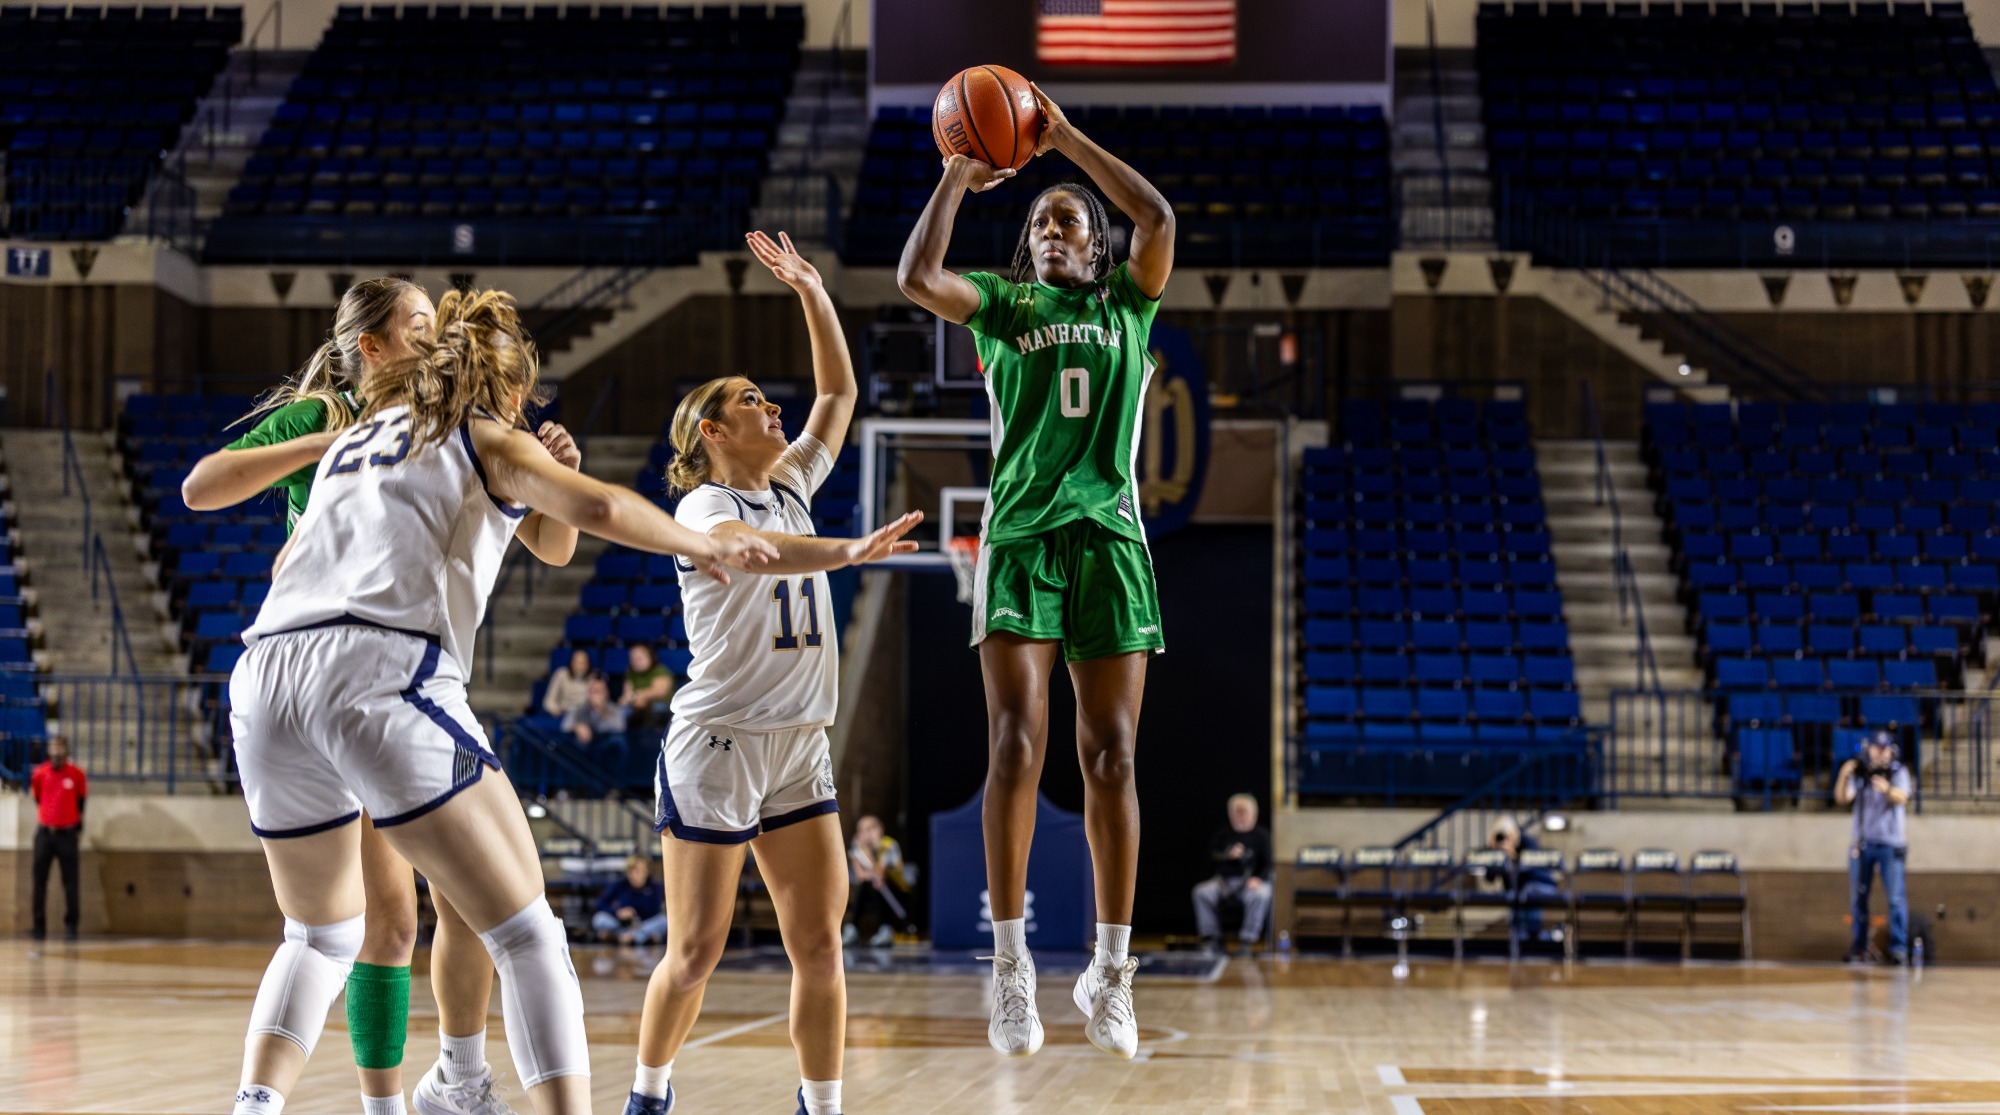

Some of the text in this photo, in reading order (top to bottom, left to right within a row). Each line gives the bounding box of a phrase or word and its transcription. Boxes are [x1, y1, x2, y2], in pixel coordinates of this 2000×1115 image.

[1016, 323, 1122, 356] MANHATTAN
[1060, 367, 1090, 418] 0
[324, 412, 413, 480] 23
[772, 576, 823, 651] 11
